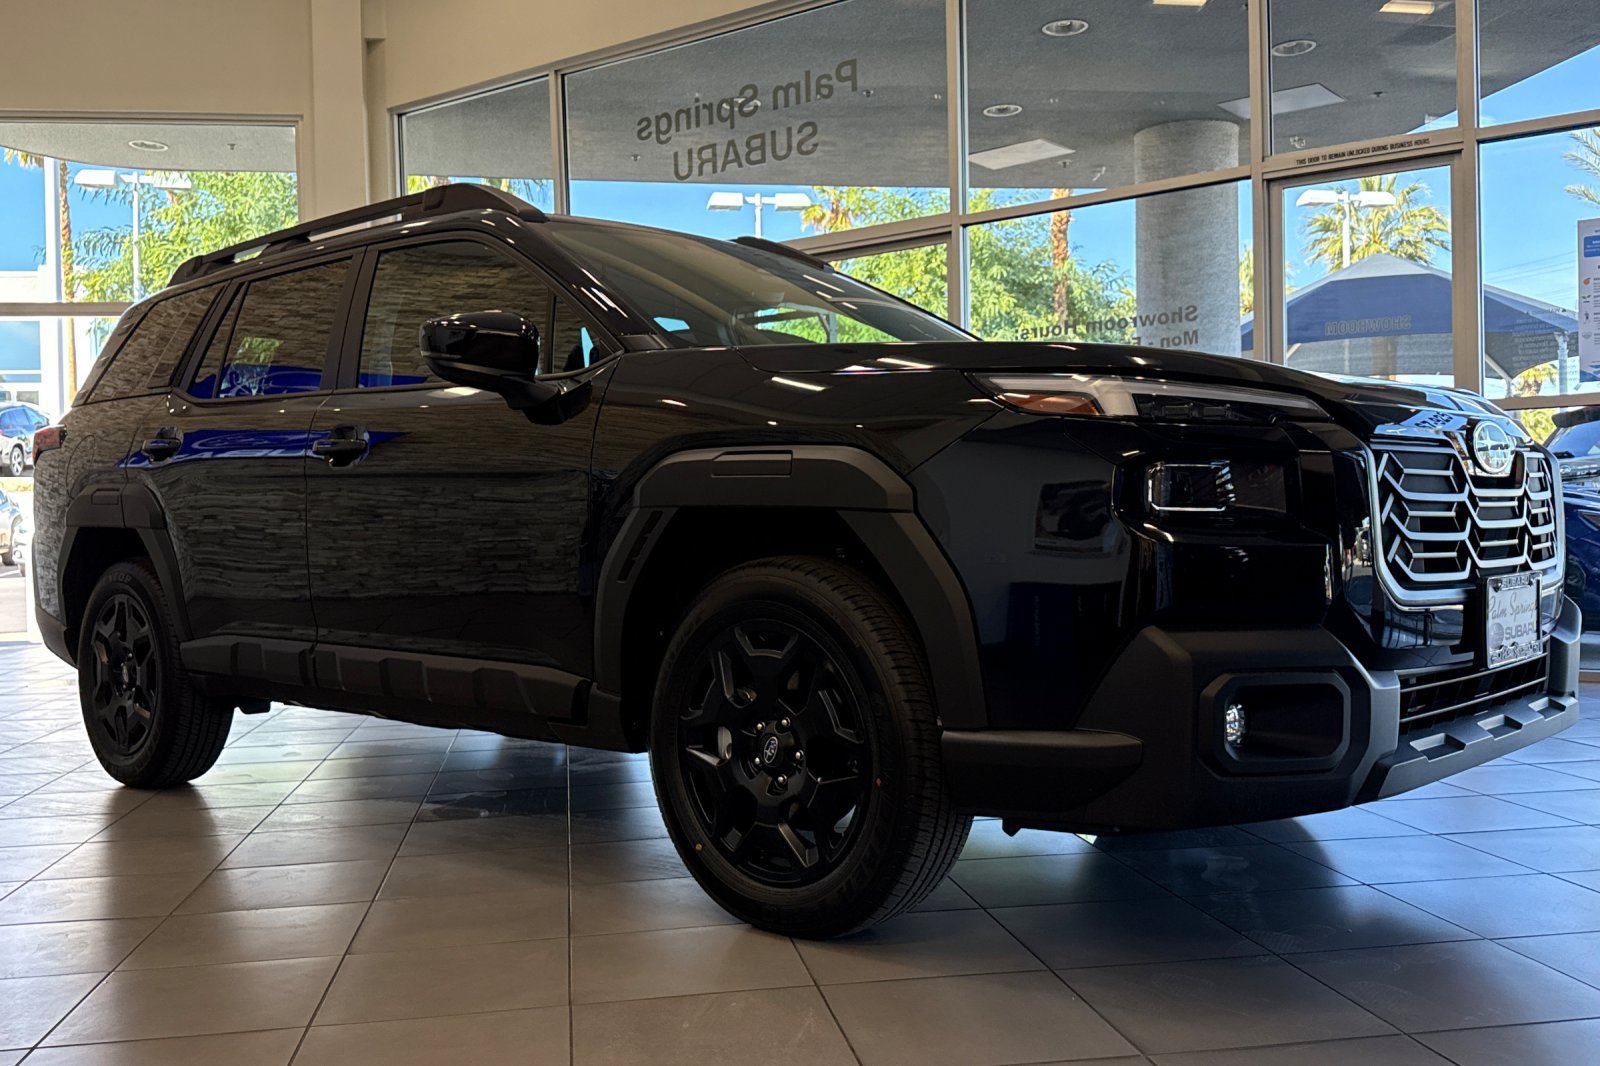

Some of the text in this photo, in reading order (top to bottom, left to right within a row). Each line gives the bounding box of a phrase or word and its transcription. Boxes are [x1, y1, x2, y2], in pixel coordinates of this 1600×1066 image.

[1296, 157, 1307, 166] THIS
[1307, 155, 1321, 164] DOOR
[1327, 151, 1346, 160] REMAIN
[1346, 147, 1371, 157] UNLOCKED
[1371, 144, 1389, 153] DURING
[1389, 140, 1413, 150] BUSINESS
[1413, 137, 1430, 146] HOURS
[1488, 595, 1507, 620] Palm
